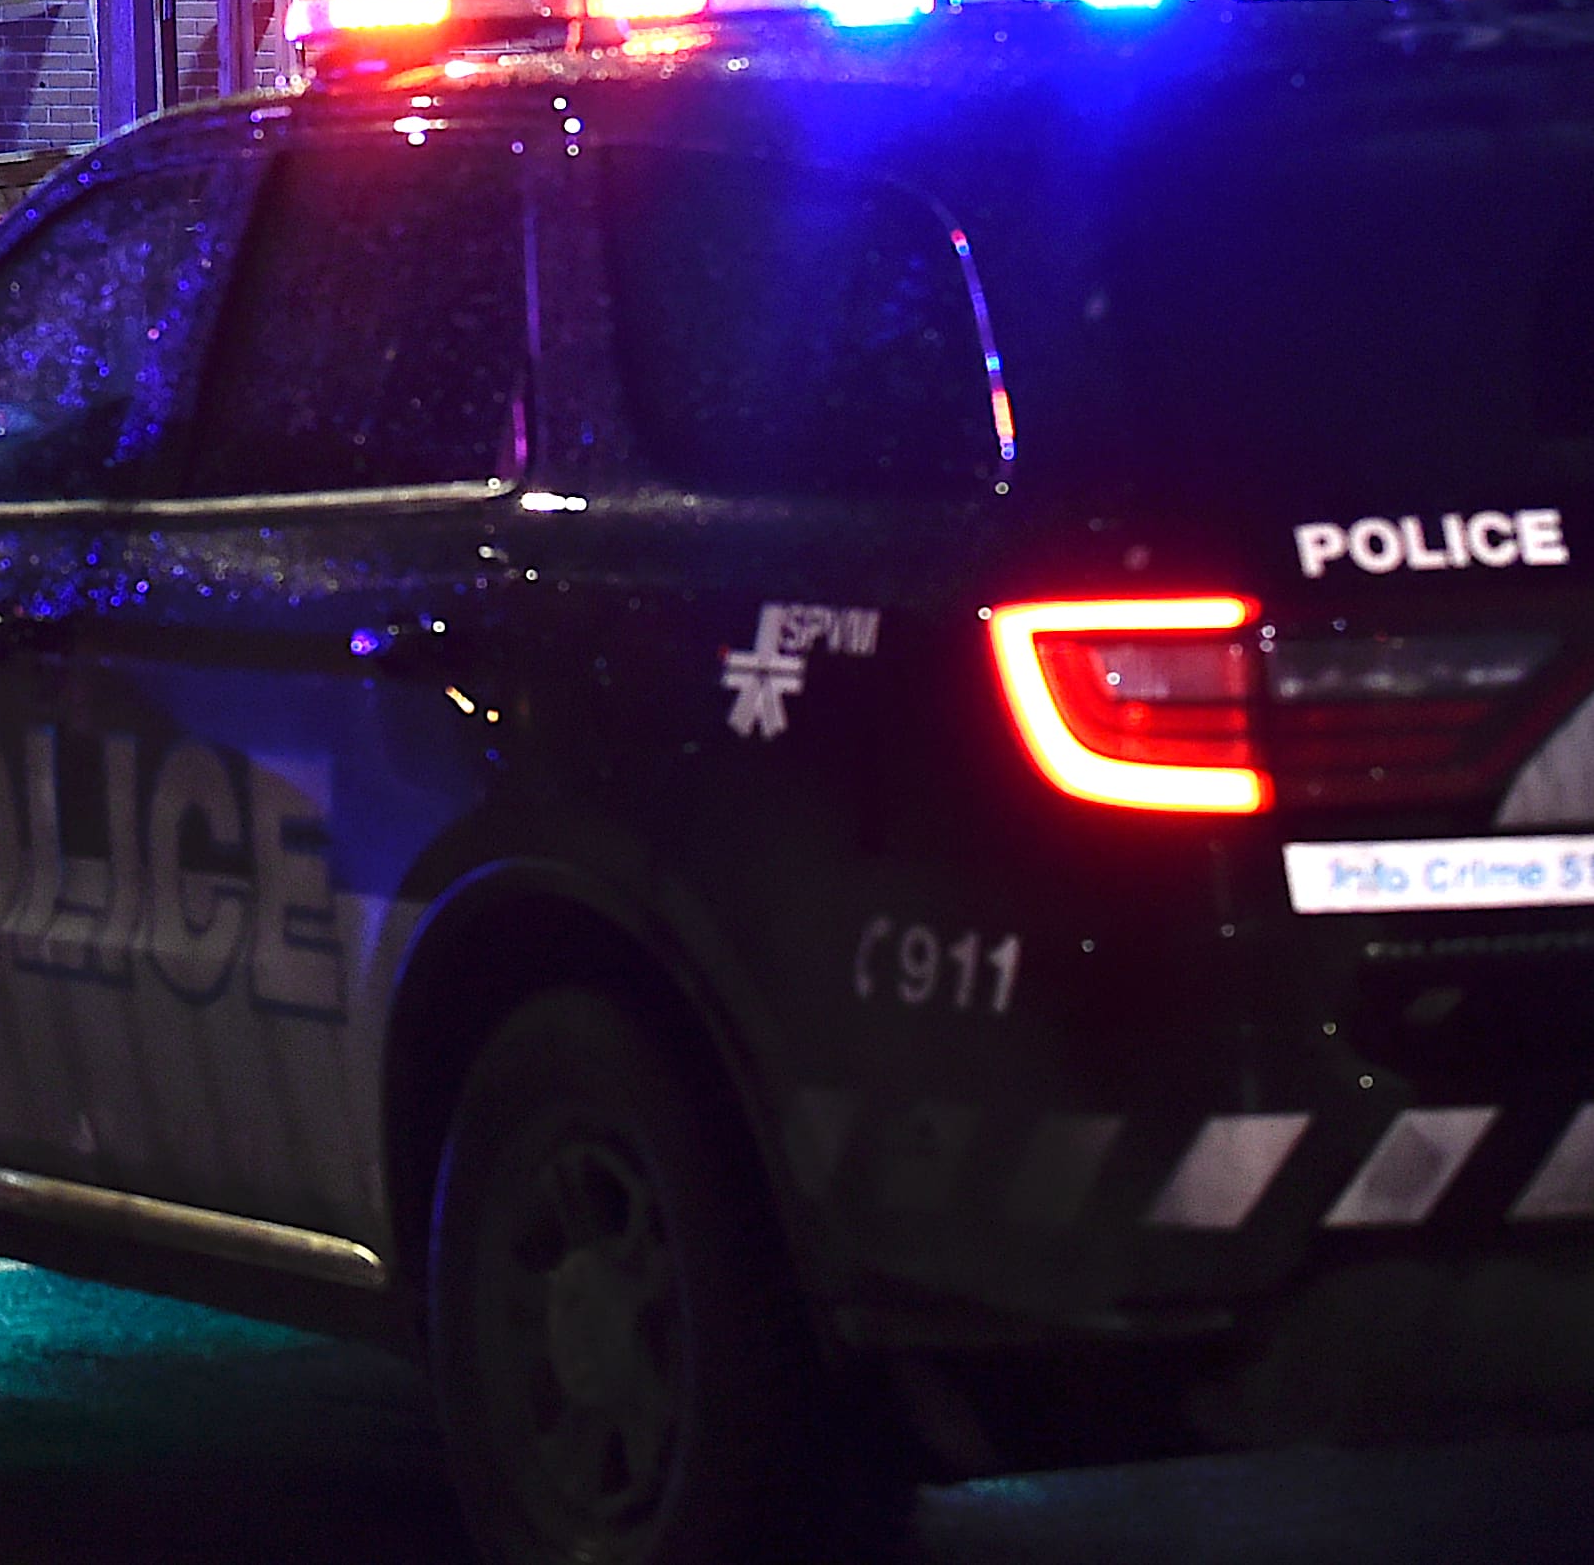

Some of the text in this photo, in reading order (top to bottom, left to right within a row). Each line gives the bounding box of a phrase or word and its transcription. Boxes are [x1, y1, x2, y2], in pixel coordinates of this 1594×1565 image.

[1293, 508, 1571, 578] POLICE
[1329, 857, 1410, 894] Info
[1422, 857, 1549, 894] Crime
[901, 923, 1024, 1015] 911
